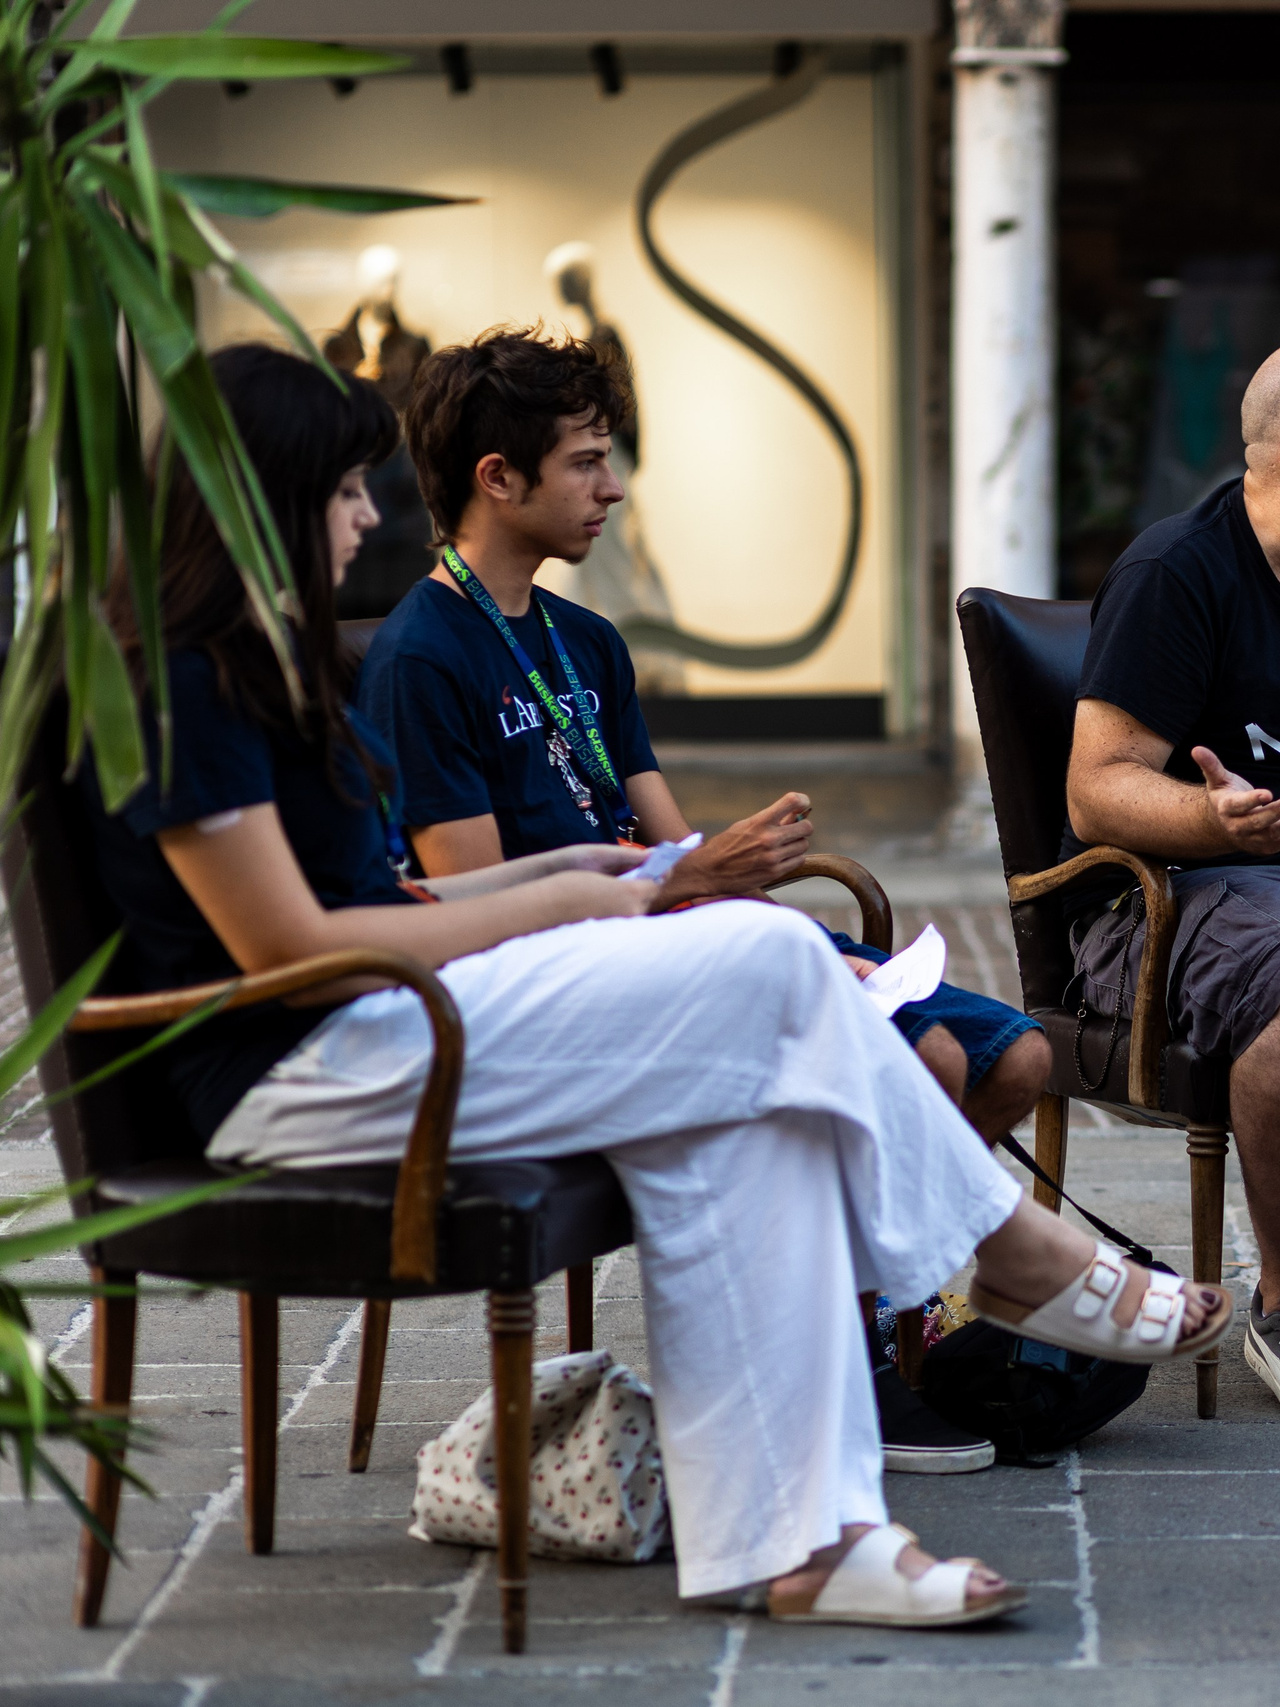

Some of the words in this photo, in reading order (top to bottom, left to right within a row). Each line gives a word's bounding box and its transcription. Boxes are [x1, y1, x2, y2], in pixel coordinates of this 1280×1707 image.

[466, 579, 519, 648] BUSKERS
[528, 670, 571, 729] BuskerS
[565, 728, 618, 797] BUSKERS
